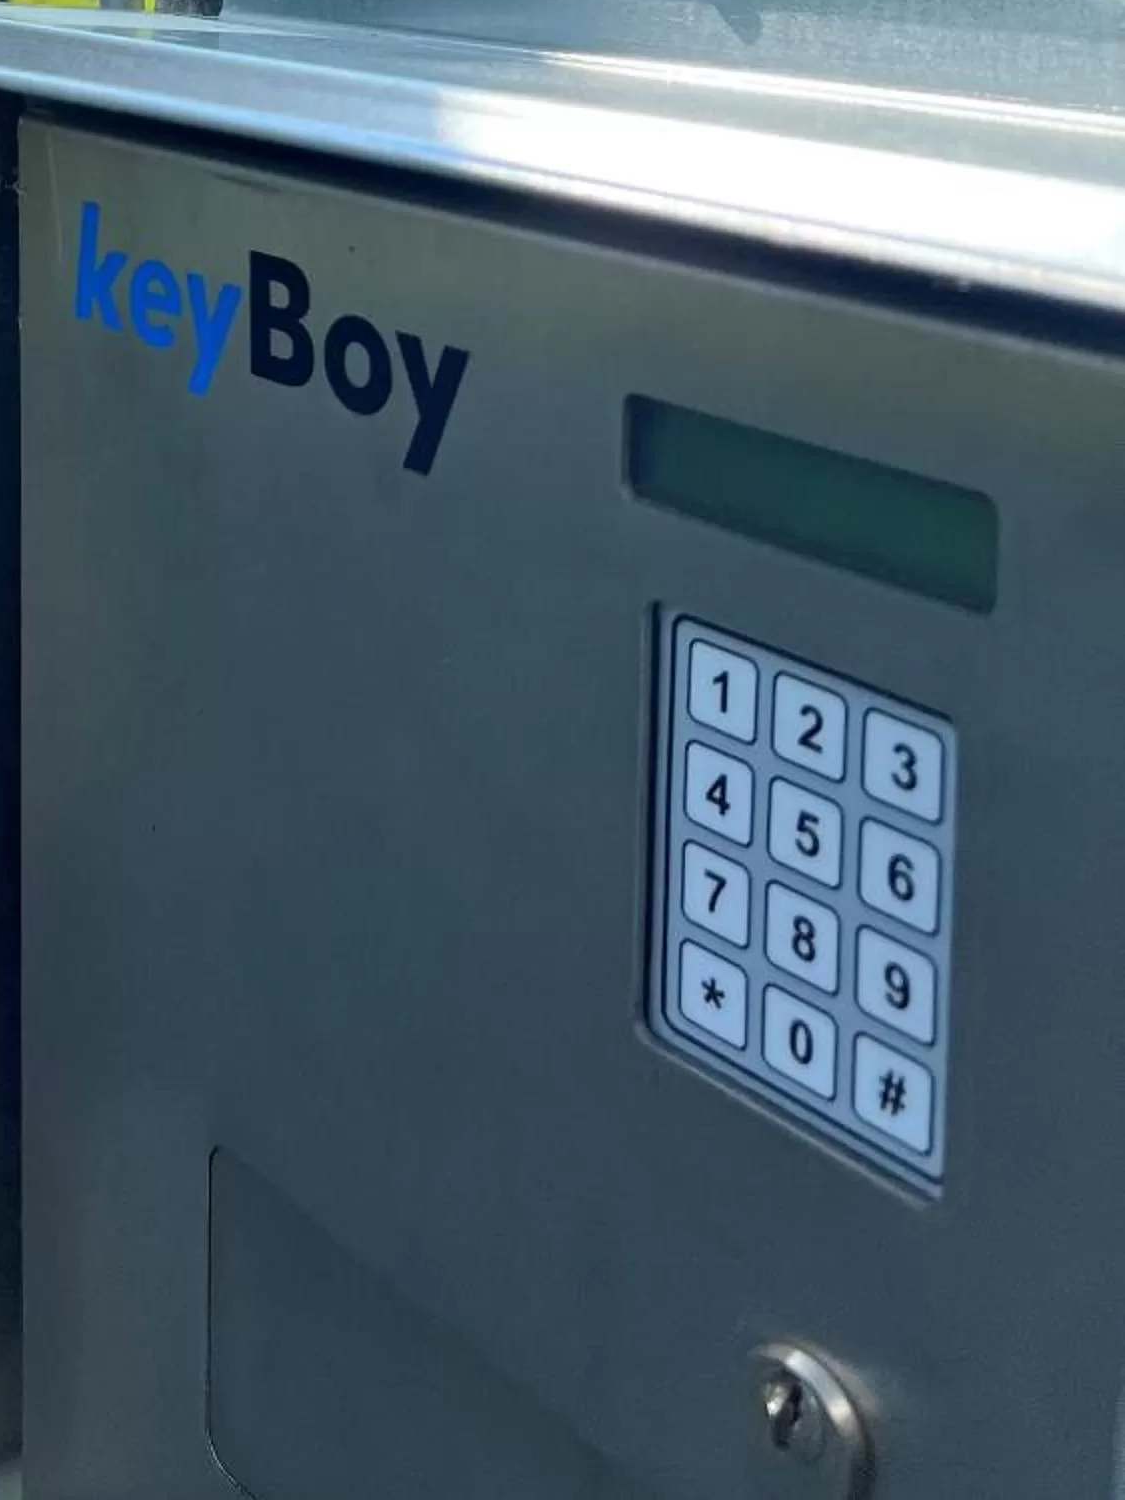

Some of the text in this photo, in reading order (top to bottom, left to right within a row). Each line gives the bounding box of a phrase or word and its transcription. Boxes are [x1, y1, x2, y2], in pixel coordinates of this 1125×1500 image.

[74, 201, 470, 476] keyBoy
[713, 672, 917, 791] 1 2 3
[706, 775, 914, 901] 4 5 6
[705, 871, 910, 1010] 7 8 9
[790, 1020, 813, 1064] 0
[880, 1072, 906, 1115] #
